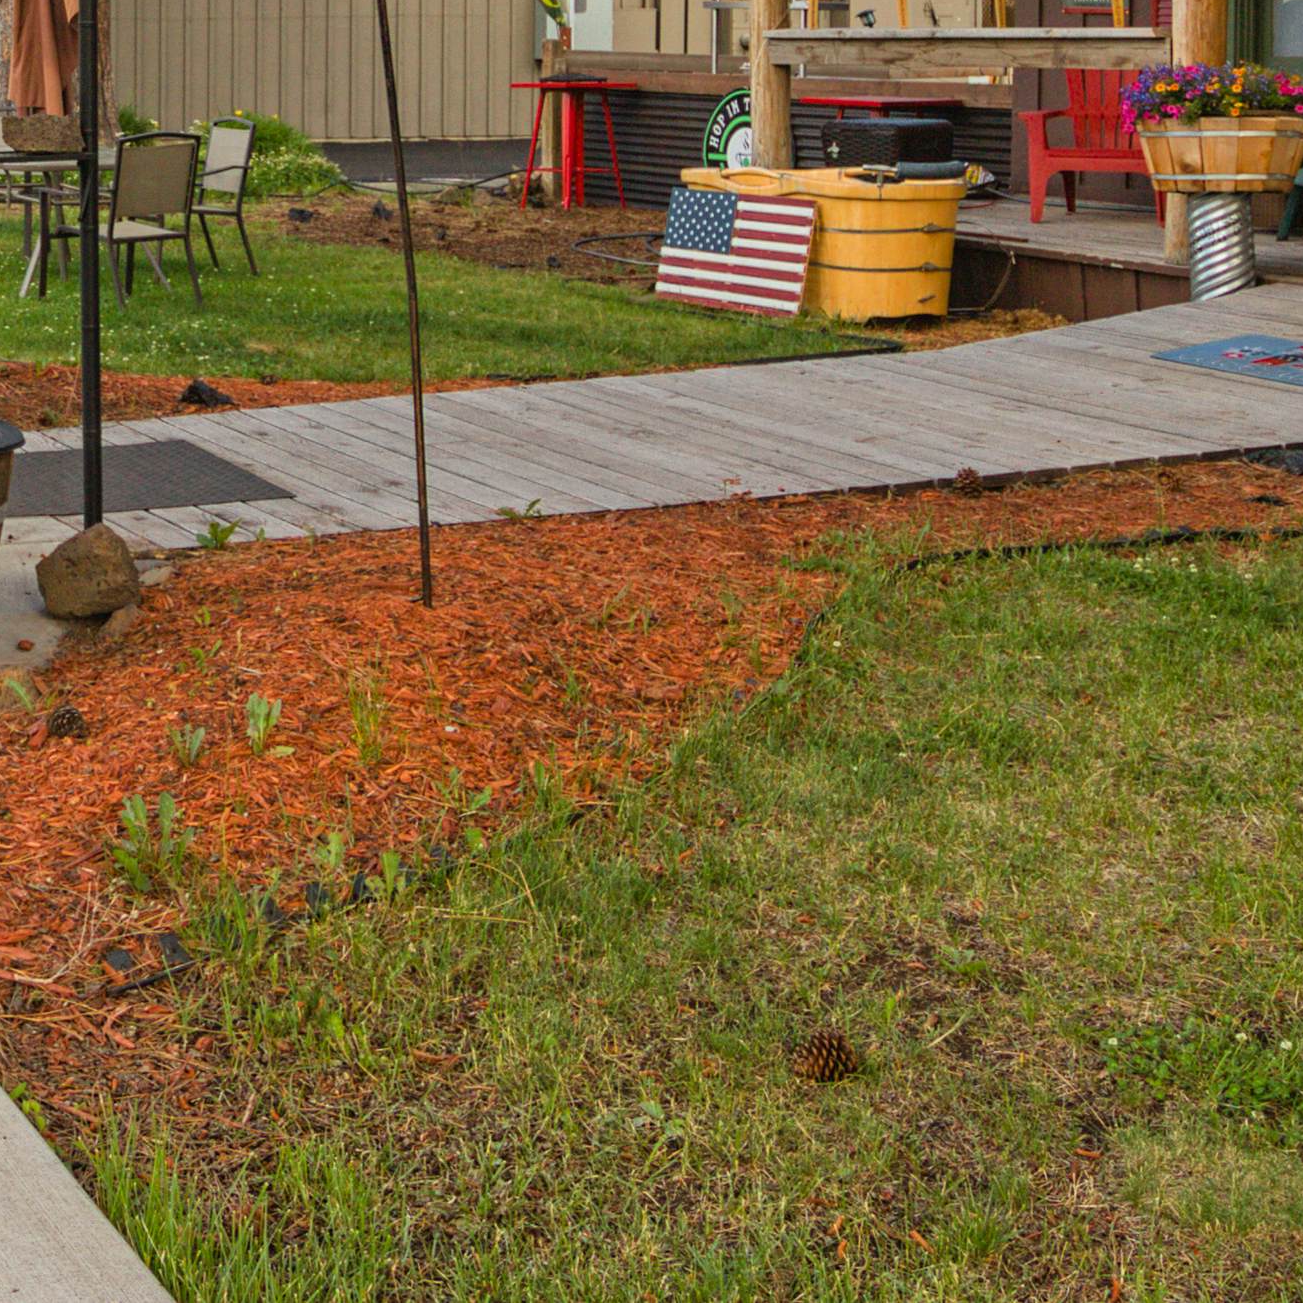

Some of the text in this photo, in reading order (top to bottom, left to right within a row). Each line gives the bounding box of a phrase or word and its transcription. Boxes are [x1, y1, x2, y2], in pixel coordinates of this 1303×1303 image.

[709, 97, 751, 149] HOP IN T
